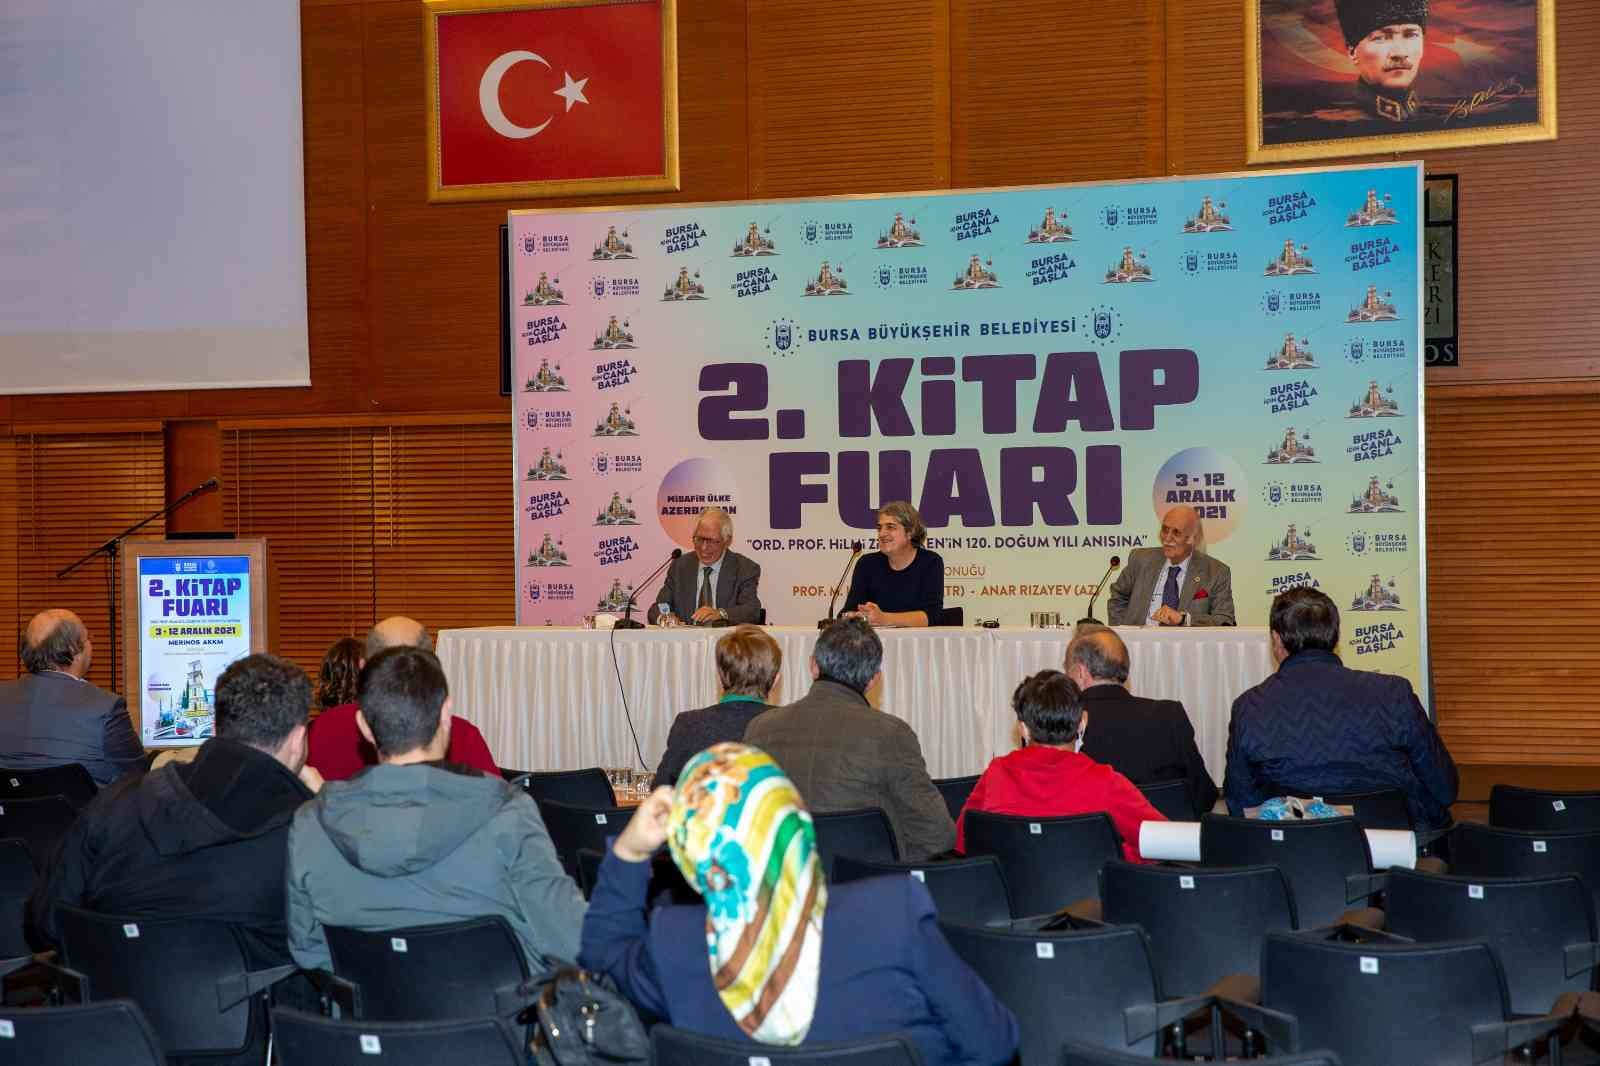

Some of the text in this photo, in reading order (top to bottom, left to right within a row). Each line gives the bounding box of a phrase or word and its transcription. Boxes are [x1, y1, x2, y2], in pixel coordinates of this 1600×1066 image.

[1269, 190, 1308, 207] BURSA
[1276, 198, 1316, 214] CANLA
[955, 208, 991, 224] BURSA
[962, 215, 999, 230] CANLA
[666, 222, 699, 237] BURSA
[672, 229, 707, 244] CANLA
[1351, 237, 1391, 253] BURSA
[1359, 244, 1400, 260] CANLA
[1031, 253, 1068, 268] BURSA
[1038, 259, 1076, 275] CANLA
[736, 267, 771, 281] BURSA
[743, 273, 778, 288] CANLA
[527, 316, 560, 330] BURSA
[533, 322, 567, 336] CANLA
[808, 317, 1077, 342] BURSA BÜYÜKŞEHİR BELEDİYESİ
[597, 360, 630, 373] BURSA
[603, 366, 637, 380] CANLA
[1270, 380, 1309, 395] BURSA
[1277, 387, 1318, 402] CANLA
[697, 362, 805, 441] 2.
[1353, 429, 1393, 444] BURSA
[1361, 436, 1402, 451] CANLA
[768, 444, 1122, 530] FUARI
[1176, 473, 1188, 486] 3
[1204, 473, 1225, 486] 12
[530, 491, 563, 504] BURSA
[707, 493, 732, 503] ÜLKE
[1165, 489, 1236, 503] ARALIK
[536, 497, 570, 512] CANLA
[599, 536, 632, 549] BURSA
[605, 542, 639, 557] CANLA
[788, 538, 826, 550] PROF.
[966, 537, 991, 549] 120.
[994, 534, 1049, 548] DOĞUM
[1052, 535, 1079, 548] YILI
[944, 564, 985, 577] ONUĞU
[1272, 571, 1311, 586] BURSA
[149, 579, 170, 597] 2.
[792, 585, 827, 597] PROF.
[980, 585, 1017, 596] ANAR
[1020, 584, 1071, 596] RIZAYEV
[162, 598, 228, 617] FUARI
[155, 627, 162, 636] 3
[168, 627, 178, 635] 12
[180, 627, 212, 635] ARALIK
[214, 626, 236, 635] 2021
[1355, 623, 1395, 637] BURSA
[1363, 630, 1403, 644] CANLA
